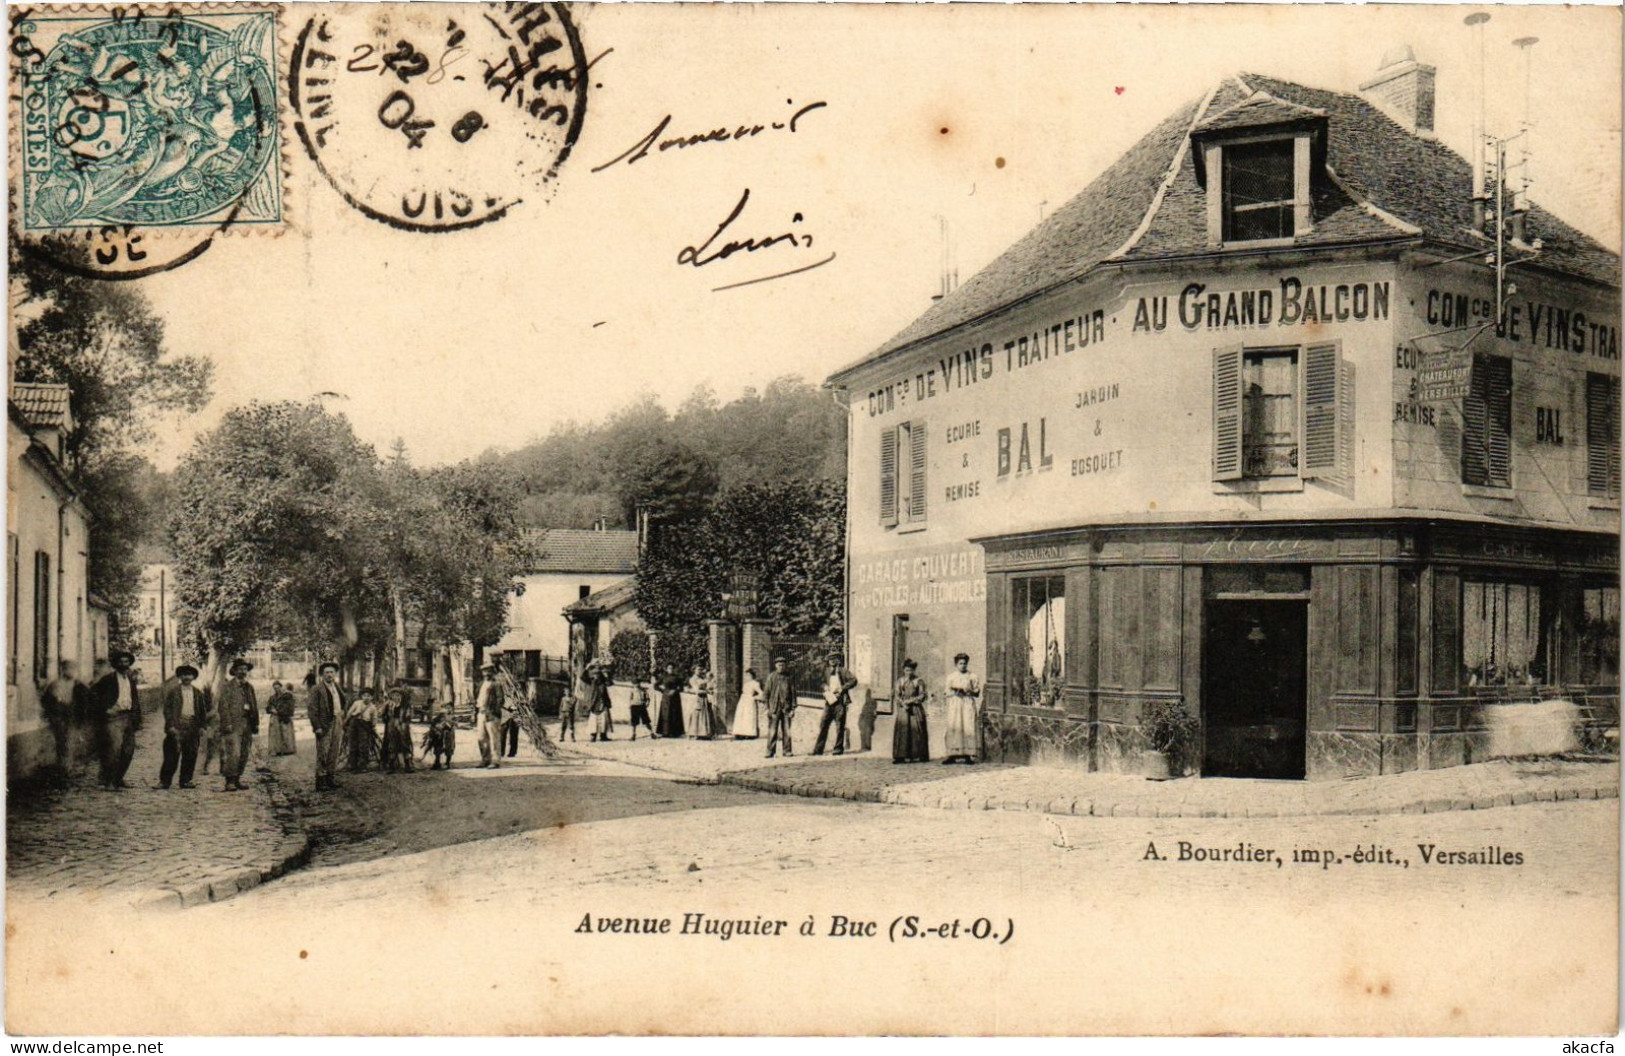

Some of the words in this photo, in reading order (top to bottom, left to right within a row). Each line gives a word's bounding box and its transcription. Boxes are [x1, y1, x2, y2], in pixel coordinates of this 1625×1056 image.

[1132, 297, 1167, 332] AU
[1178, 281, 1273, 328] GRAND
[1279, 275, 1391, 325] BALCON
[1527, 302, 1586, 353] VINS
[916, 369, 937, 402] DE
[939, 342, 993, 393] VINS
[1003, 309, 1105, 372] TRAITEUR
[1075, 383, 1120, 409] JARDIN
[1419, 386, 1471, 401] VERSAILLES
[1094, 418, 1103, 436] &
[1396, 403, 1436, 427] REMISE
[1536, 406, 1564, 443] BAL
[962, 452, 969, 468] &
[997, 417, 1053, 478] BAL
[1071, 450, 1123, 476] BOSQUET
[945, 481, 980, 501] REMISE
[859, 559, 907, 584] GARAGE
[913, 551, 978, 579] COUVERT
[872, 585, 909, 607] CYCLES
[920, 578, 987, 605] AUTOMOBILES
[1143, 842, 1168, 862] A.
[1178, 842, 1283, 868] Bourdier,
[1293, 846, 1410, 870] imp.-édit.,
[1418, 844, 1525, 866] Versailles
[574, 913, 672, 934] Avenue
[680, 913, 789, 941] Huguier
[799, 915, 816, 936] à
[828, 915, 878, 937] Buc
[888, 915, 1016, 945] (S.-et-O.)
